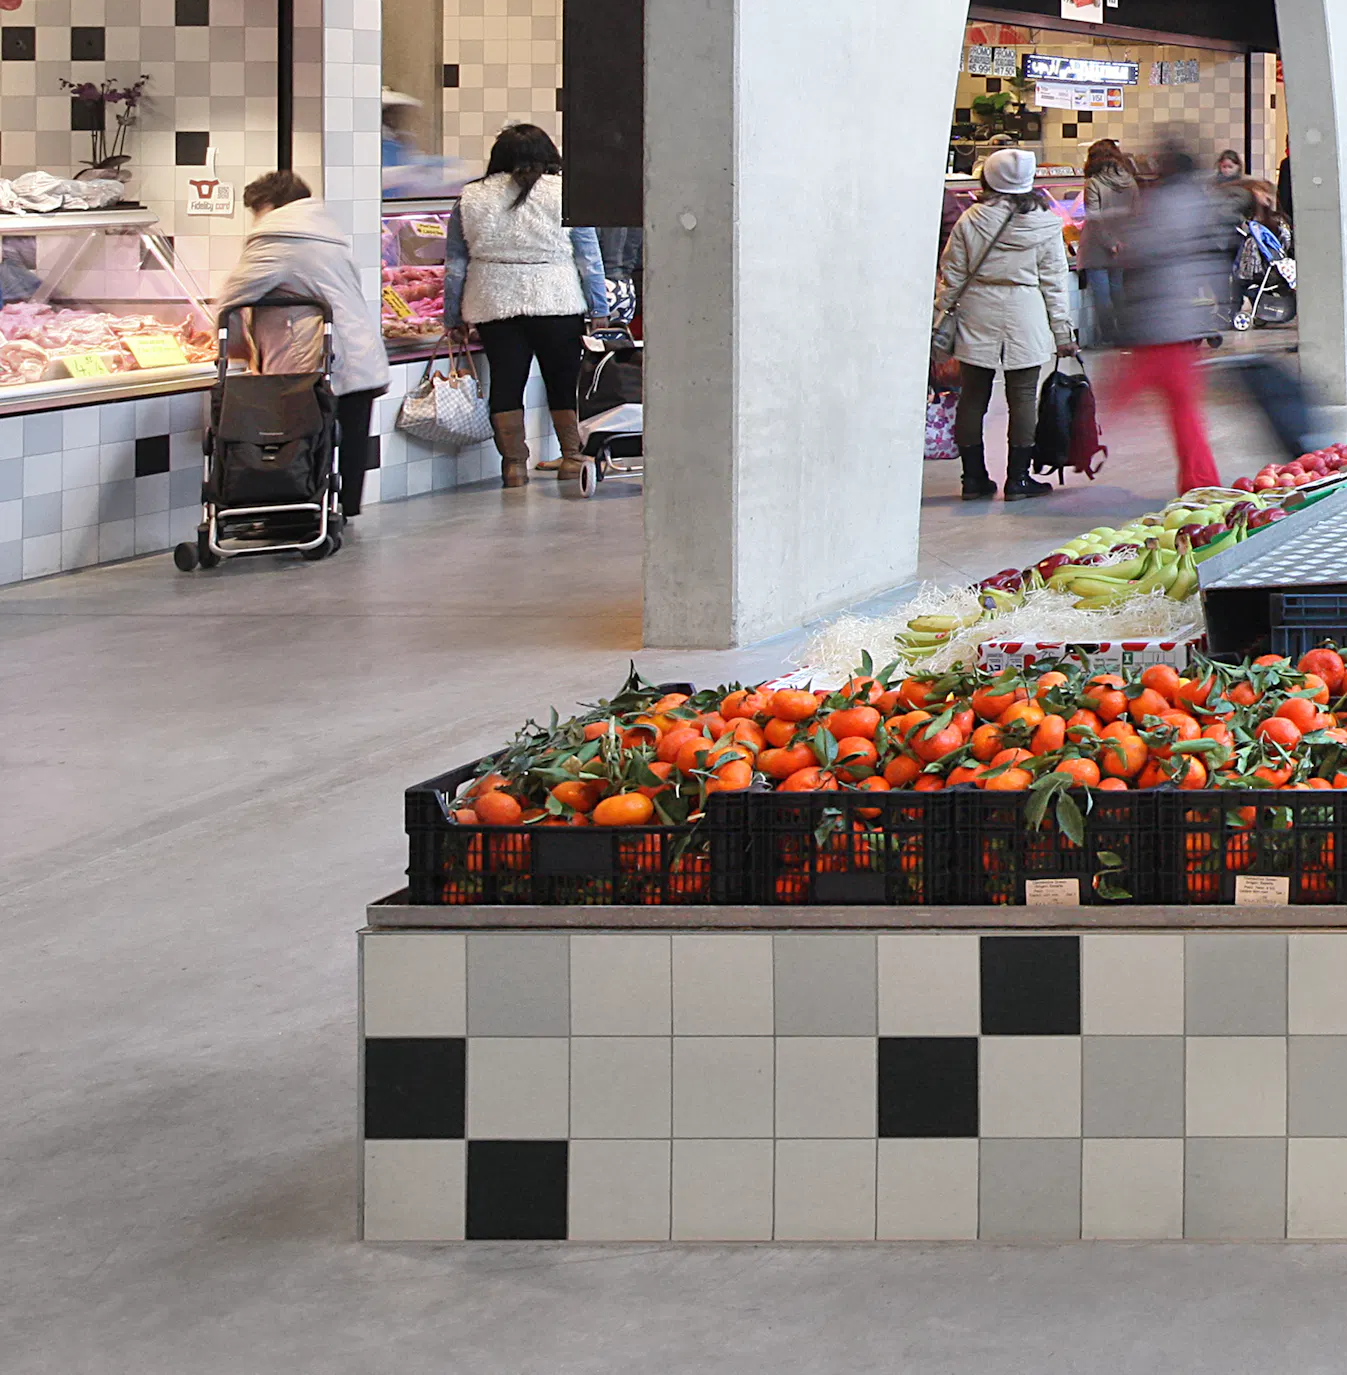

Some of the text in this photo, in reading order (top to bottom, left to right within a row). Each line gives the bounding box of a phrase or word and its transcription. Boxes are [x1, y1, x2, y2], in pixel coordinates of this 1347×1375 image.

[1092, 94, 1103, 102] VISA
[191, 201, 231, 212] Fidelity card
